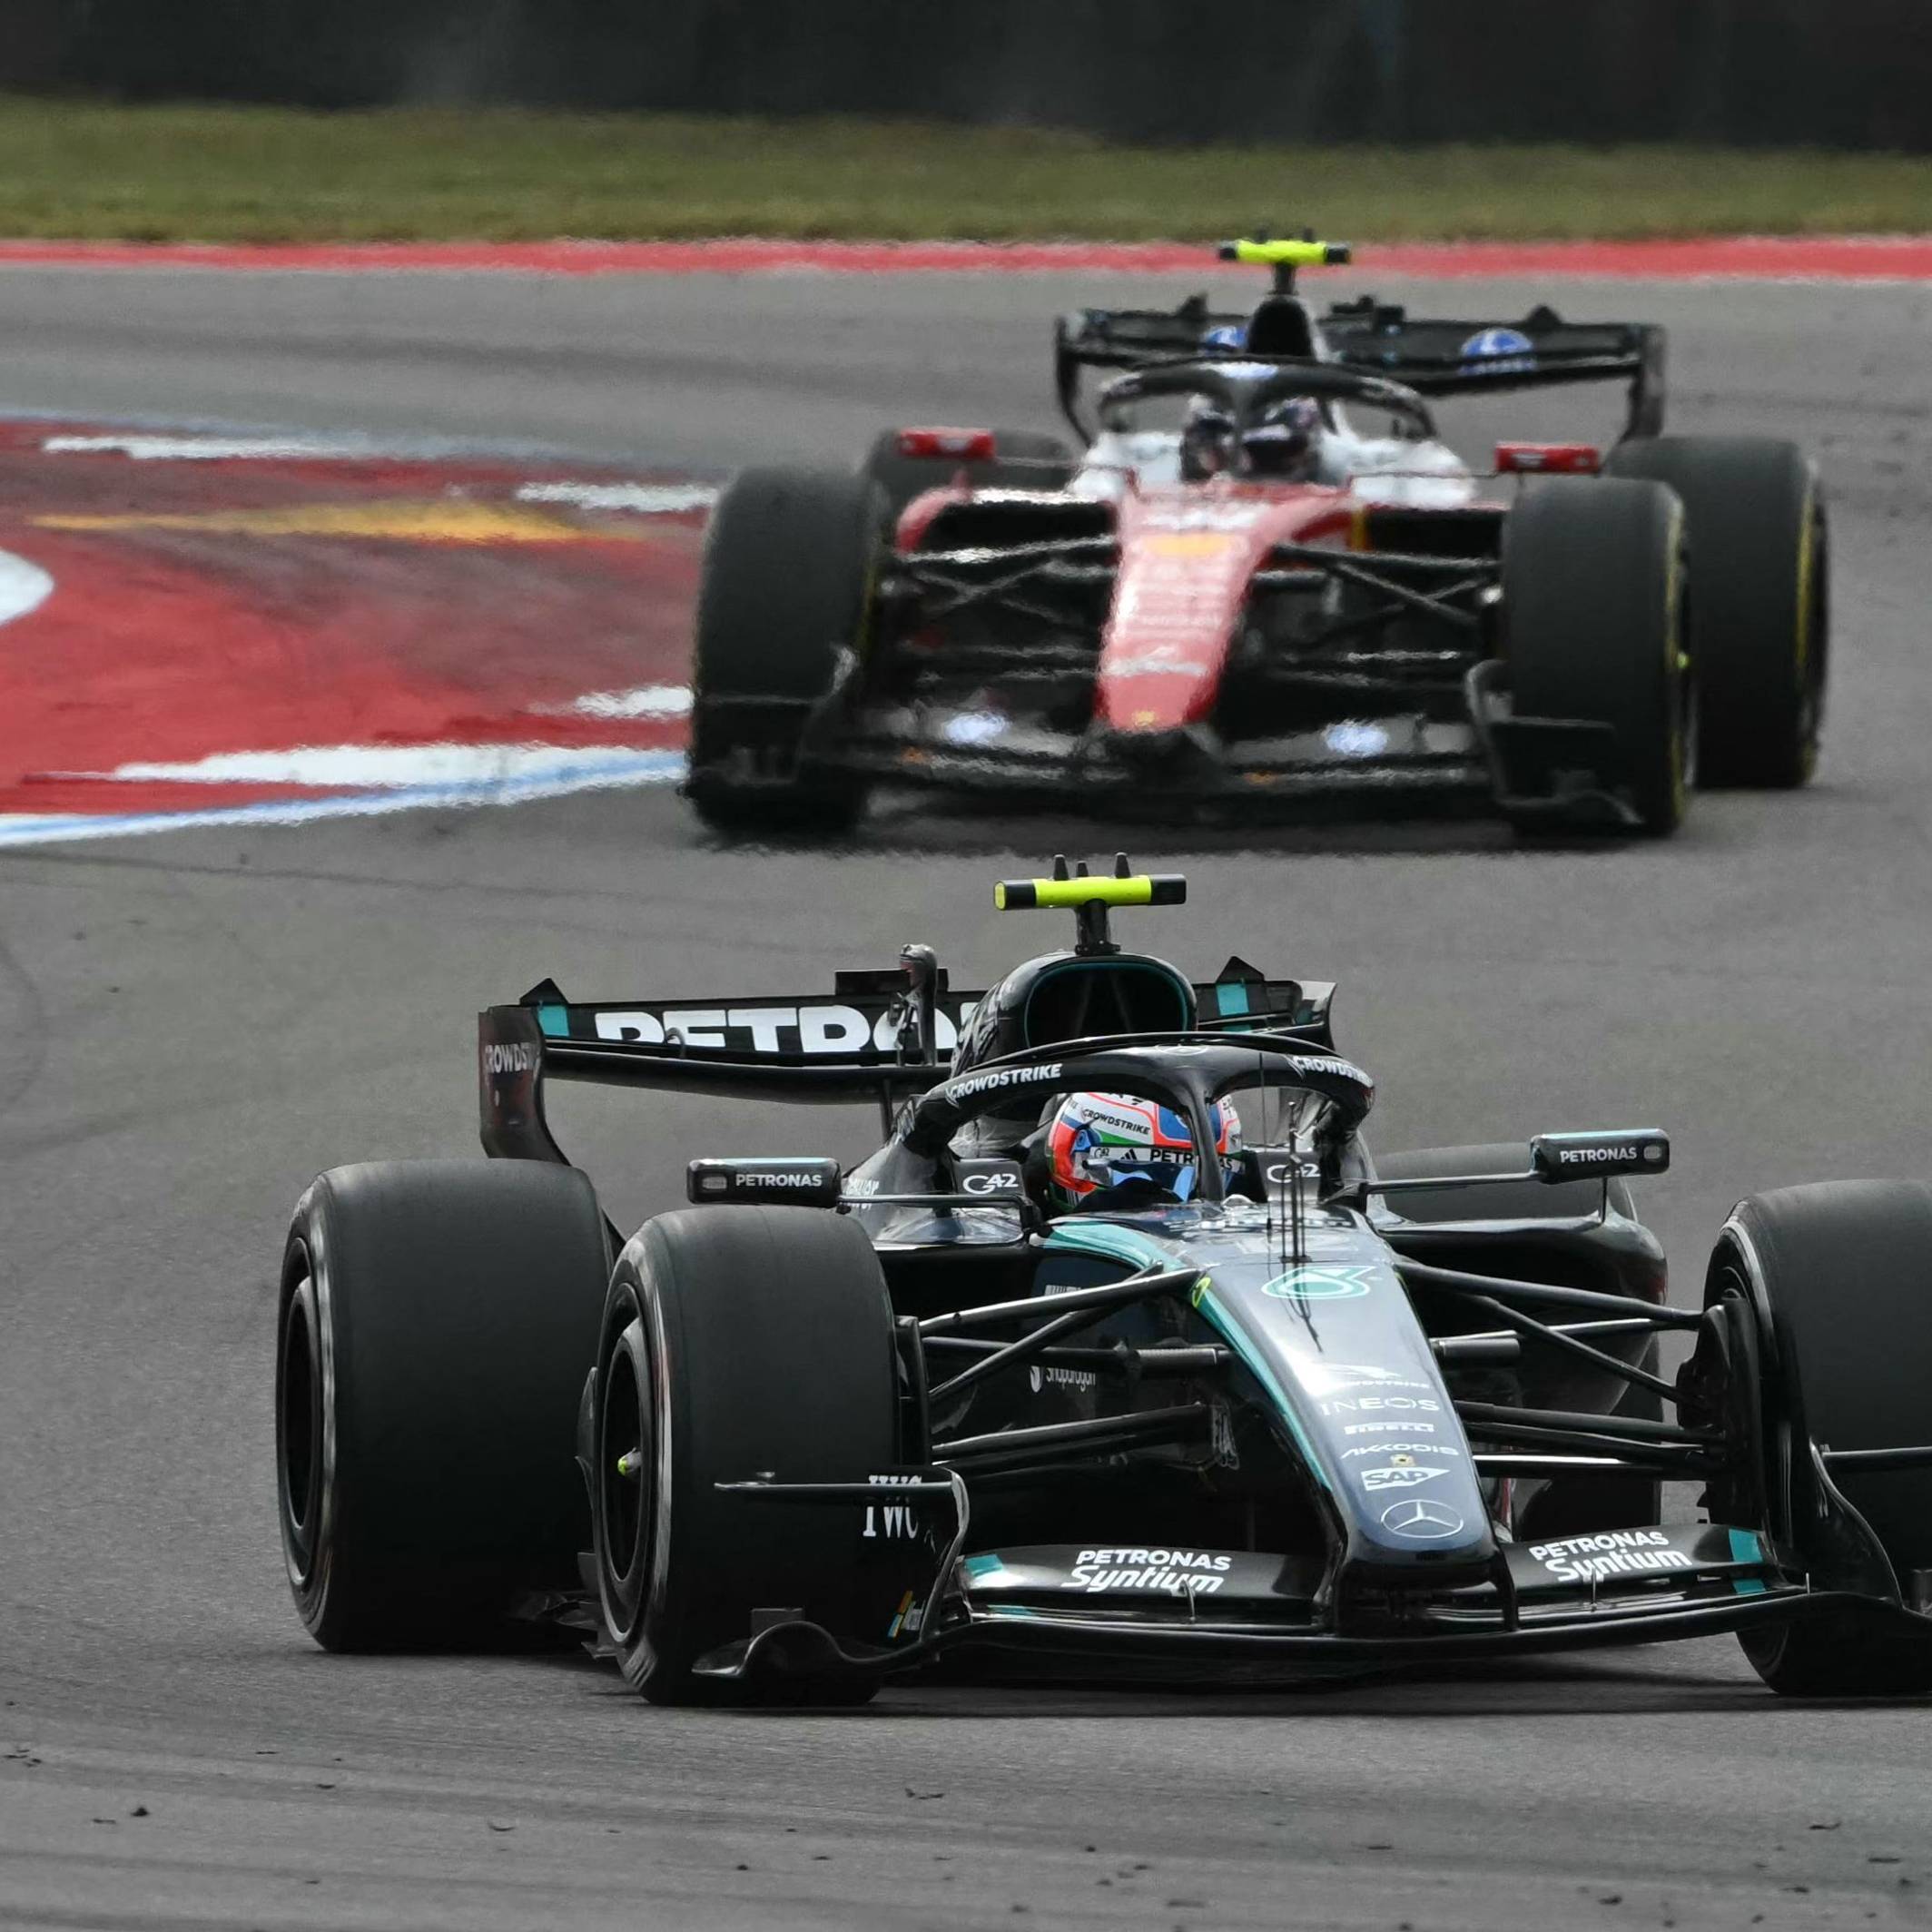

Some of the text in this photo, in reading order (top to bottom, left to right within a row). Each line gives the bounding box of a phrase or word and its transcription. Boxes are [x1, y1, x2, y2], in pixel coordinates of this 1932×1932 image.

[951, 1063, 1063, 1099] CROWDSTRIKE
[1083, 1109, 1150, 1135] CROWDSTRIKE
[1150, 1148, 1233, 1170] PETRAS
[1559, 1148, 1637, 1163] PETRONAS
[735, 1174, 823, 1187] PETRONAS
[962, 1173, 1019, 1195] G42
[1321, 1397, 1440, 1415] INEOS
[1365, 1470, 1429, 1486] SAP
[1529, 1532, 1669, 1561] PETRONAS
[1076, 1549, 1232, 1571] PETRONAS
[1544, 1548, 1693, 1582] Syntium
[1060, 1564, 1225, 1593] Syntium
